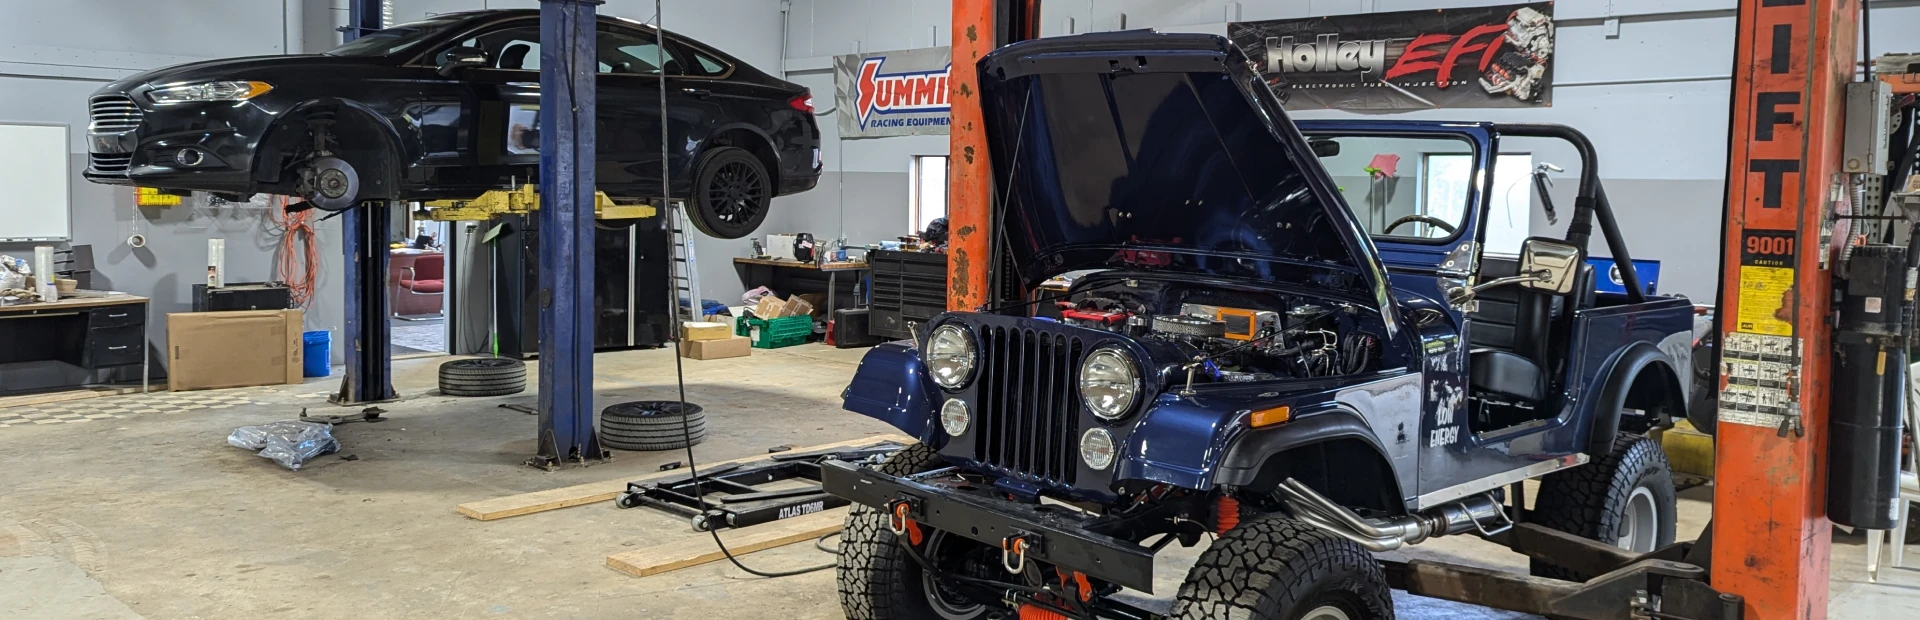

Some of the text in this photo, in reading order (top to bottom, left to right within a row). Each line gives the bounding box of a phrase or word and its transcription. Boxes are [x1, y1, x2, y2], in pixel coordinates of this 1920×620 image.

[1265, 24, 1508, 87] Holley EFI
[856, 58, 951, 124] SUMMI
[1398, 80, 1468, 88] INJECTION
[1750, 0, 1806, 208] IFT
[871, 117, 951, 128] RACING EQUIPMEN
[1747, 236, 1793, 255] 9001
[1436, 407, 1454, 427] LOW
[1430, 425, 1459, 448] ENERGY
[779, 501, 824, 519] ATLAS TD6MR
